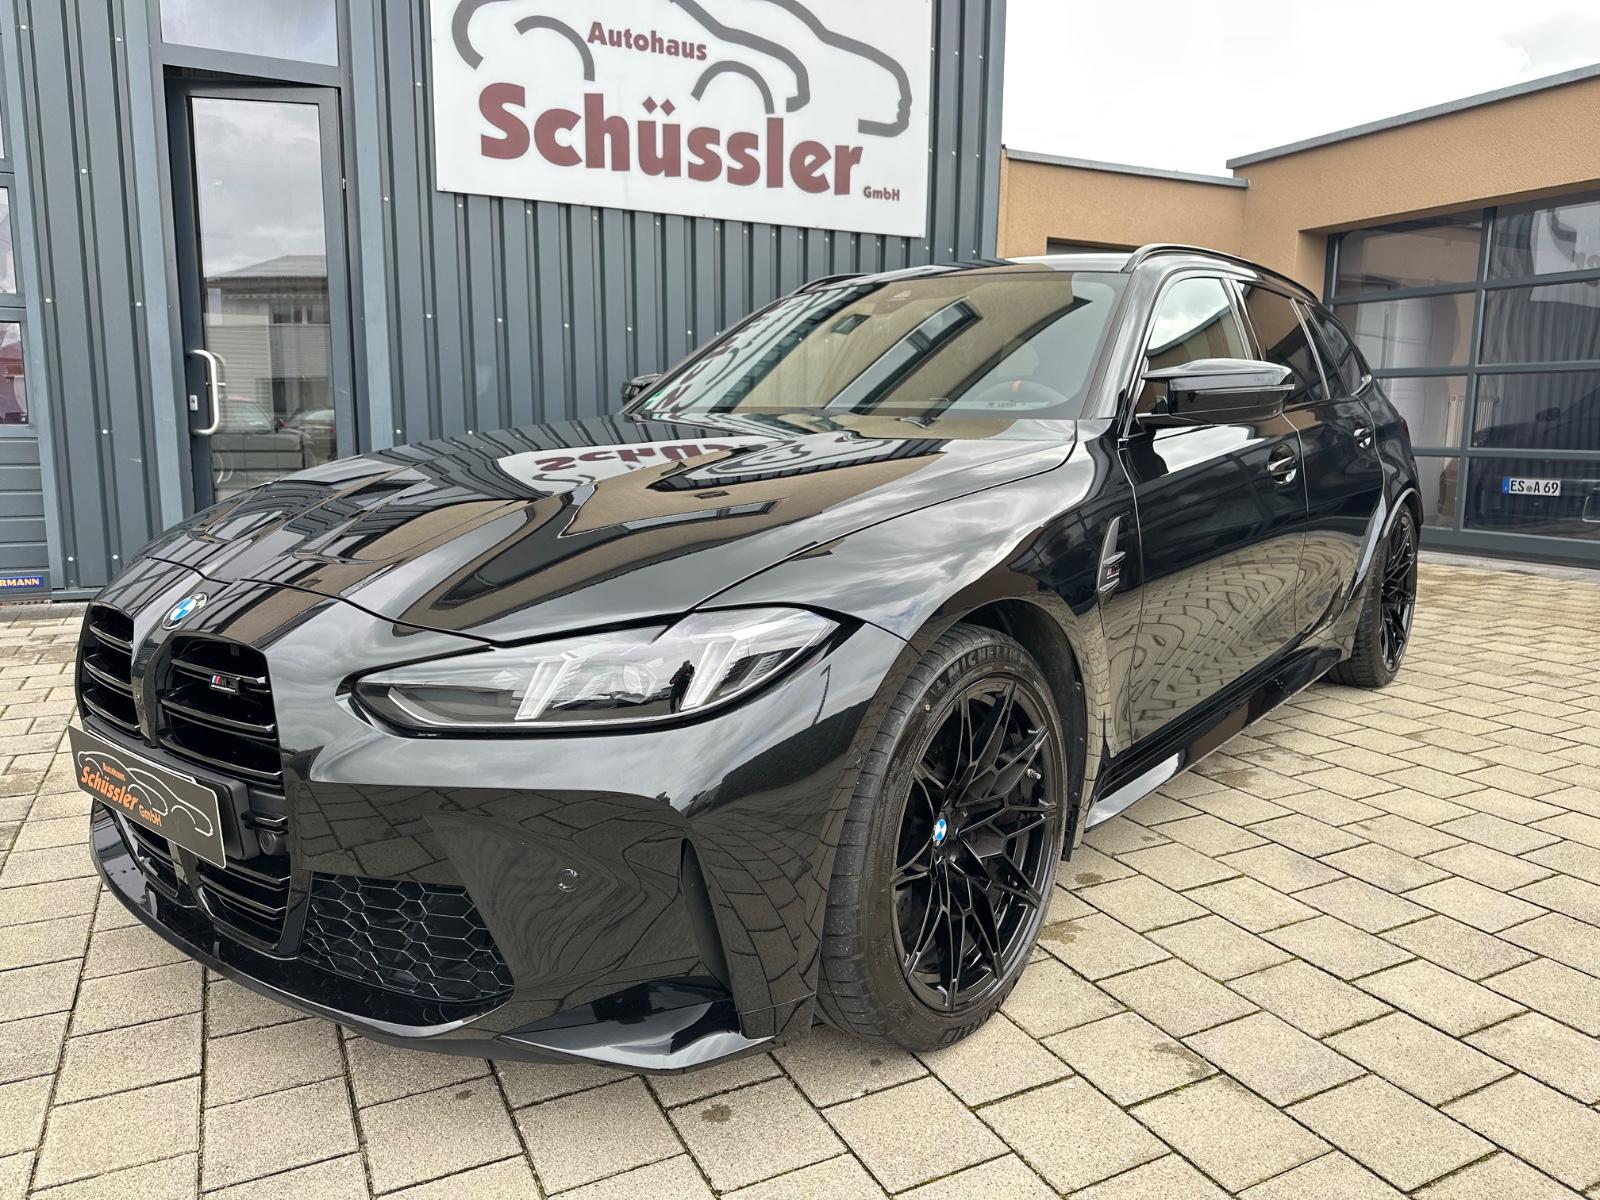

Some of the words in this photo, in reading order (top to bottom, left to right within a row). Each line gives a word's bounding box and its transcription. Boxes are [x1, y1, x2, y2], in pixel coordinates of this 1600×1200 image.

[587, 22, 707, 61] Autohaus
[479, 83, 863, 195] Schüssler
[863, 186, 900, 202] GmbH
[1510, 480, 1525, 492] ES
[1533, 481, 1540, 493] A
[1543, 481, 1559, 494] 69
[947, 646, 1018, 683] MICHELIN
[81, 766, 139, 810] Schüssler
[139, 805, 162, 827] GmbH
